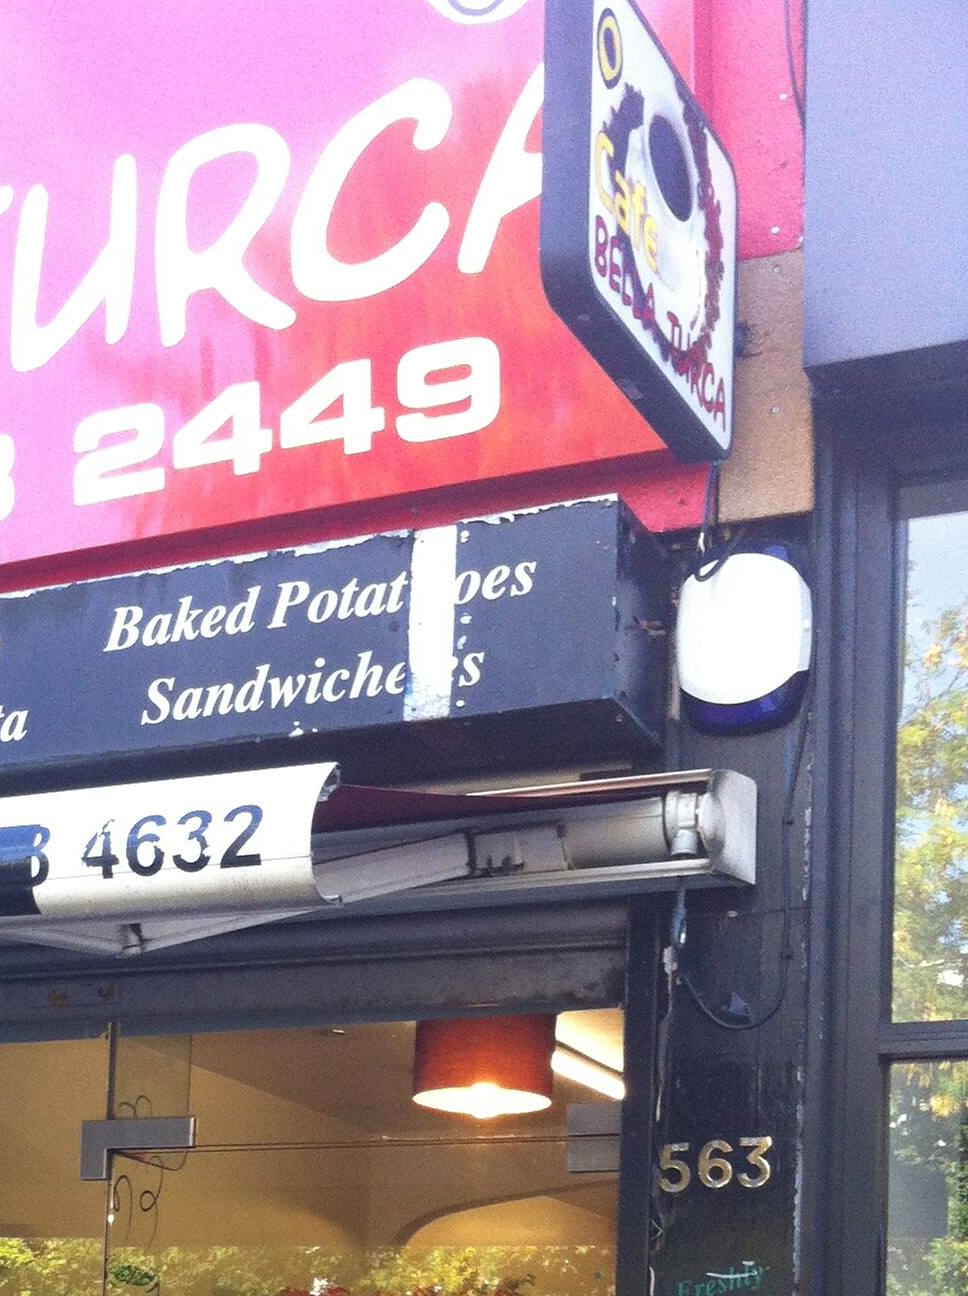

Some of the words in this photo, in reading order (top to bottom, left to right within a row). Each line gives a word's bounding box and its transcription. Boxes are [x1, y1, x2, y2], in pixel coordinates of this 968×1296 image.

[595, 130, 659, 276] Cafe
[594, 215, 656, 325] BELLA
[667, 310, 727, 432] TURCA
[72, 337, 502, 508] 2449
[104, 586, 262, 653] Baked
[81, 804, 263, 880] 4632
[658, 1135, 773, 1194] 563
